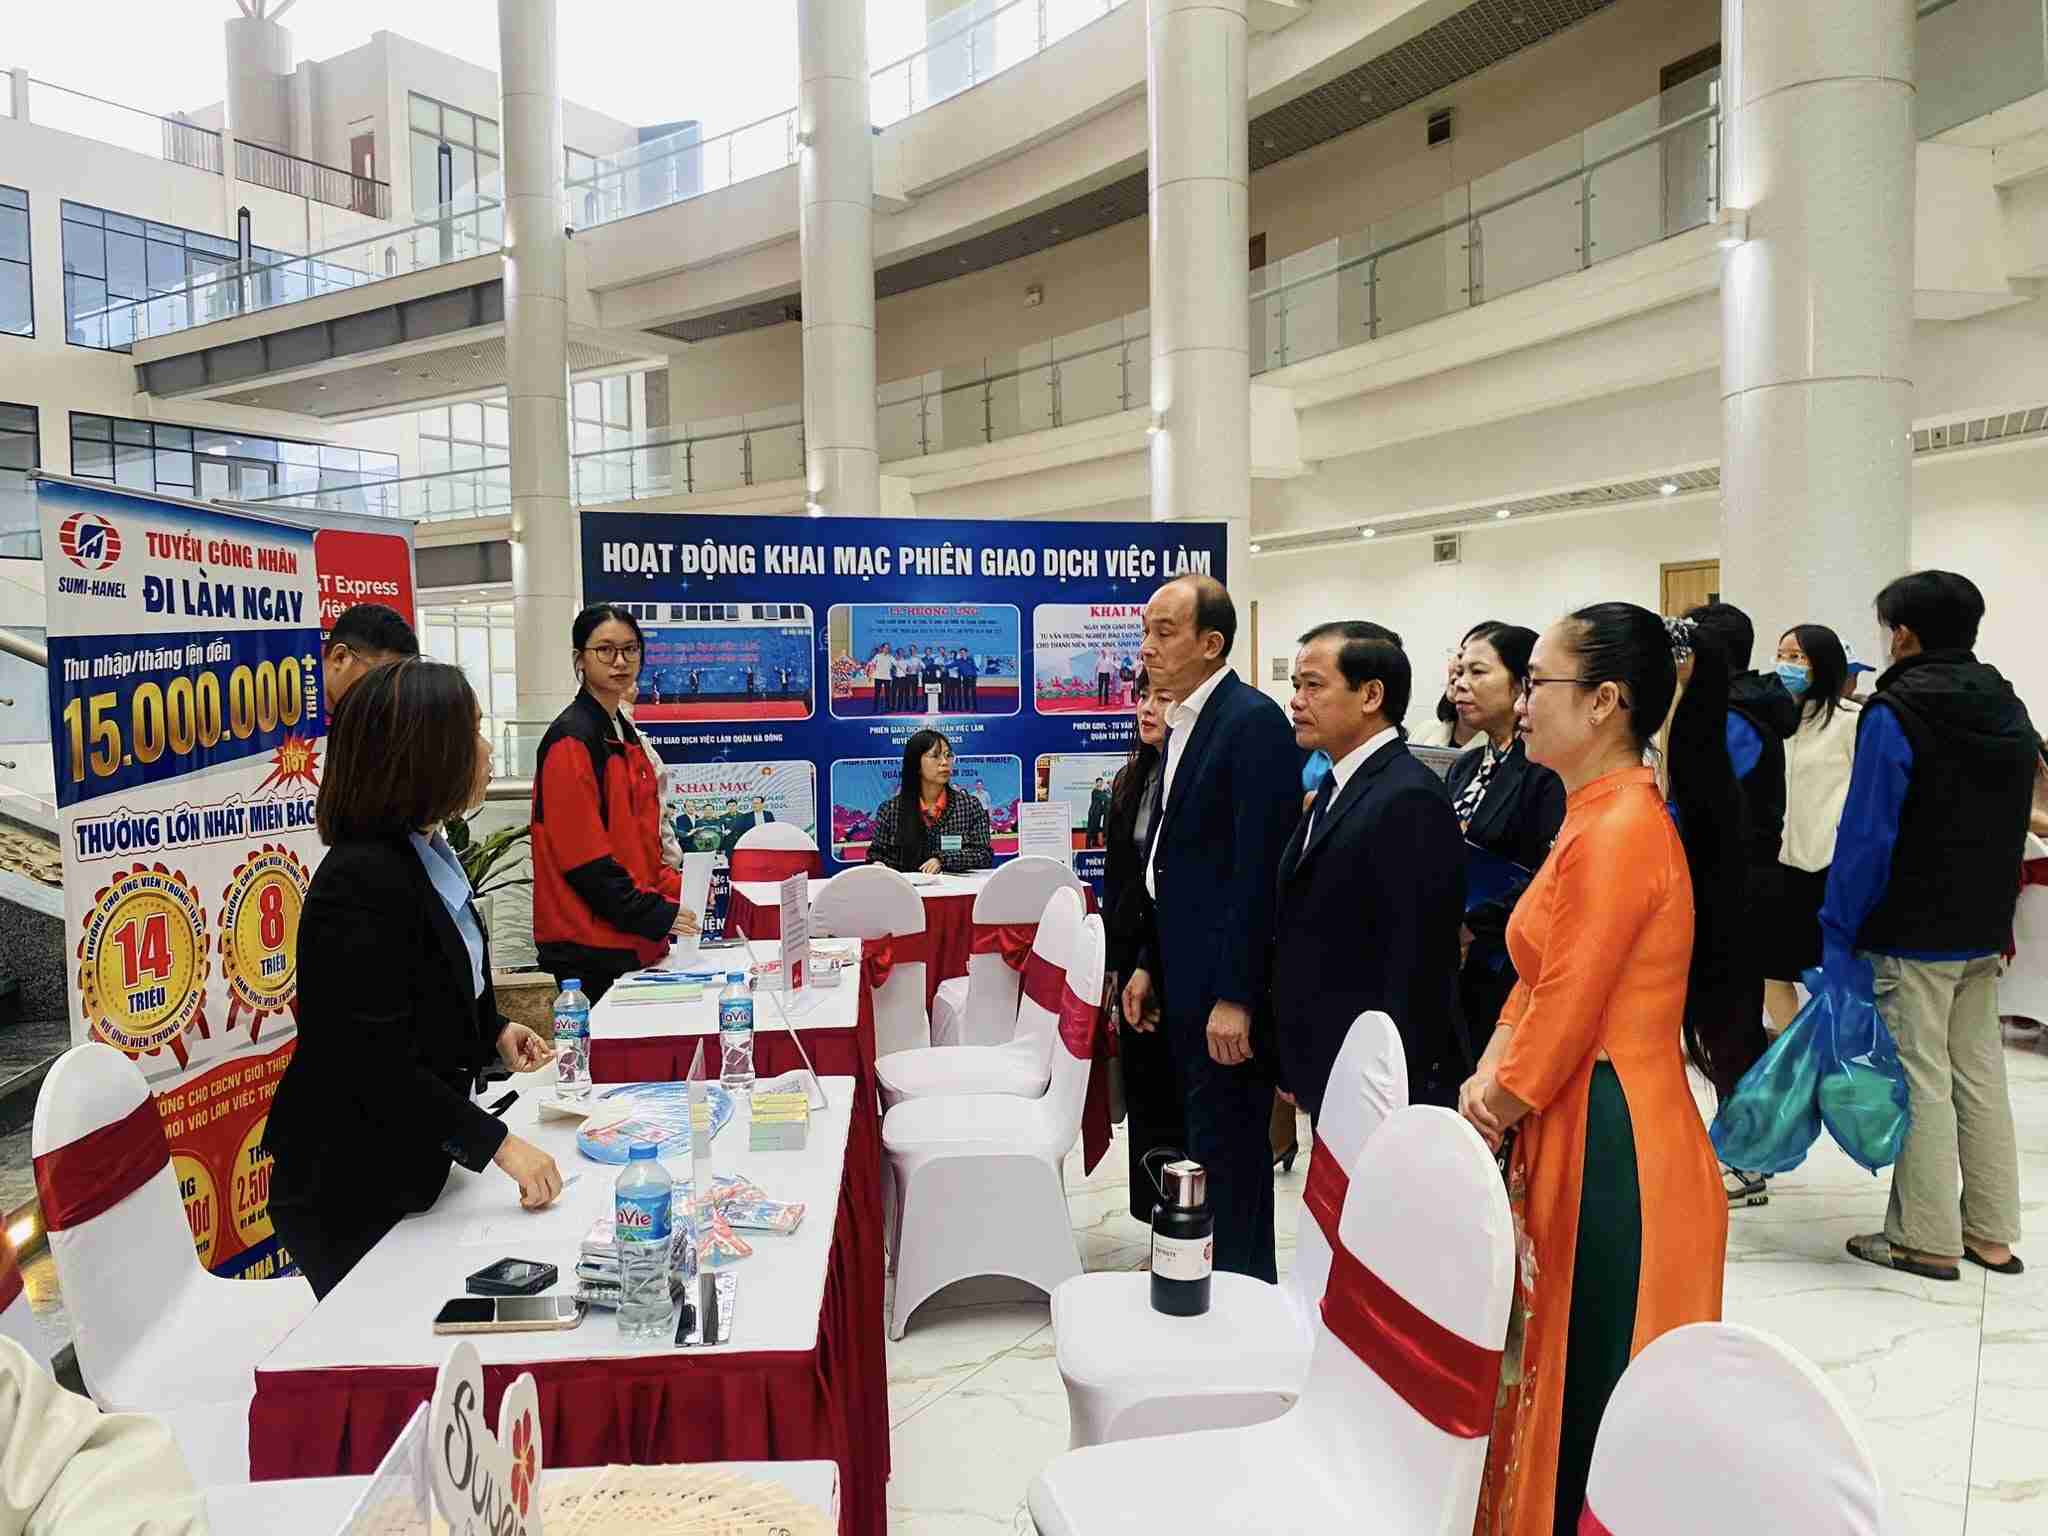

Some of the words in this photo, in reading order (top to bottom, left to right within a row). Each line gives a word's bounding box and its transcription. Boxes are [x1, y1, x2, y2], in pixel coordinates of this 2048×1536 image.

[145, 528, 203, 563] TUYỂN
[208, 539, 254, 569] CÔNG
[257, 546, 298, 576] NHÂN
[602, 542, 674, 580] HOẠT
[681, 538, 756, 581] ĐỘNG
[764, 544, 826, 576] KHAI
[833, 546, 892, 582] MẠC
[899, 541, 973, 576] PHIÊN
[981, 549, 1036, 577] GIAO
[1044, 549, 1098, 583] DỊCH
[1104, 544, 1156, 583] VIỆC
[1163, 544, 1212, 577] LÀM
[58, 576, 128, 599] SUMI-HANEL
[142, 575, 176, 615] ĐI
[182, 568, 237, 619] LÀM
[242, 586, 304, 624] NGAY
[335, 575, 400, 599] Express
[1090, 605, 1126, 618] KHAI
[64, 658, 90, 683] Thu
[93, 646, 183, 683] nhập/tháng
[185, 643, 204, 667] lên
[206, 637, 232, 662] đến
[305, 674, 319, 721] TRIỆU
[63, 656, 303, 784] 15.000.000
[869, 725, 889, 736] PHIÊN
[890, 725, 906, 735] GIAO
[1072, 721, 1091, 731] PHIÊN
[663, 735, 681, 745] GIAO
[681, 735, 699, 746] DỊCH
[699, 734, 716, 745] VIỆC
[716, 733, 732, 744] LÀM
[674, 782, 714, 795] KHAI
[719, 781, 754, 797] MẠC
[77, 812, 161, 856] THƯỞNG
[165, 807, 200, 844] LỚN
[204, 799, 245, 840] NHẤT
[250, 795, 285, 833] MIỀN
[286, 792, 316, 826] BẮC
[239, 866, 254, 885] CHO
[103, 889, 120, 912] CHO
[141, 876, 161, 889] VIÊN
[163, 880, 189, 907] TRUNG
[258, 883, 286, 952] 8
[113, 912, 174, 990] 14
[260, 951, 287, 977] TRIỆU
[127, 986, 166, 1014] TRIỆU
[151, 1021, 180, 1044] TRUNG
[188, 1088, 209, 1108] CHO
[210, 1071, 242, 1098] CBCNV
[188, 1109, 209, 1132] VÀO
[210, 1098, 230, 1122] LÀM
[232, 1086, 256, 1111] VIỆC
[616, 1208, 652, 1226] aVie
